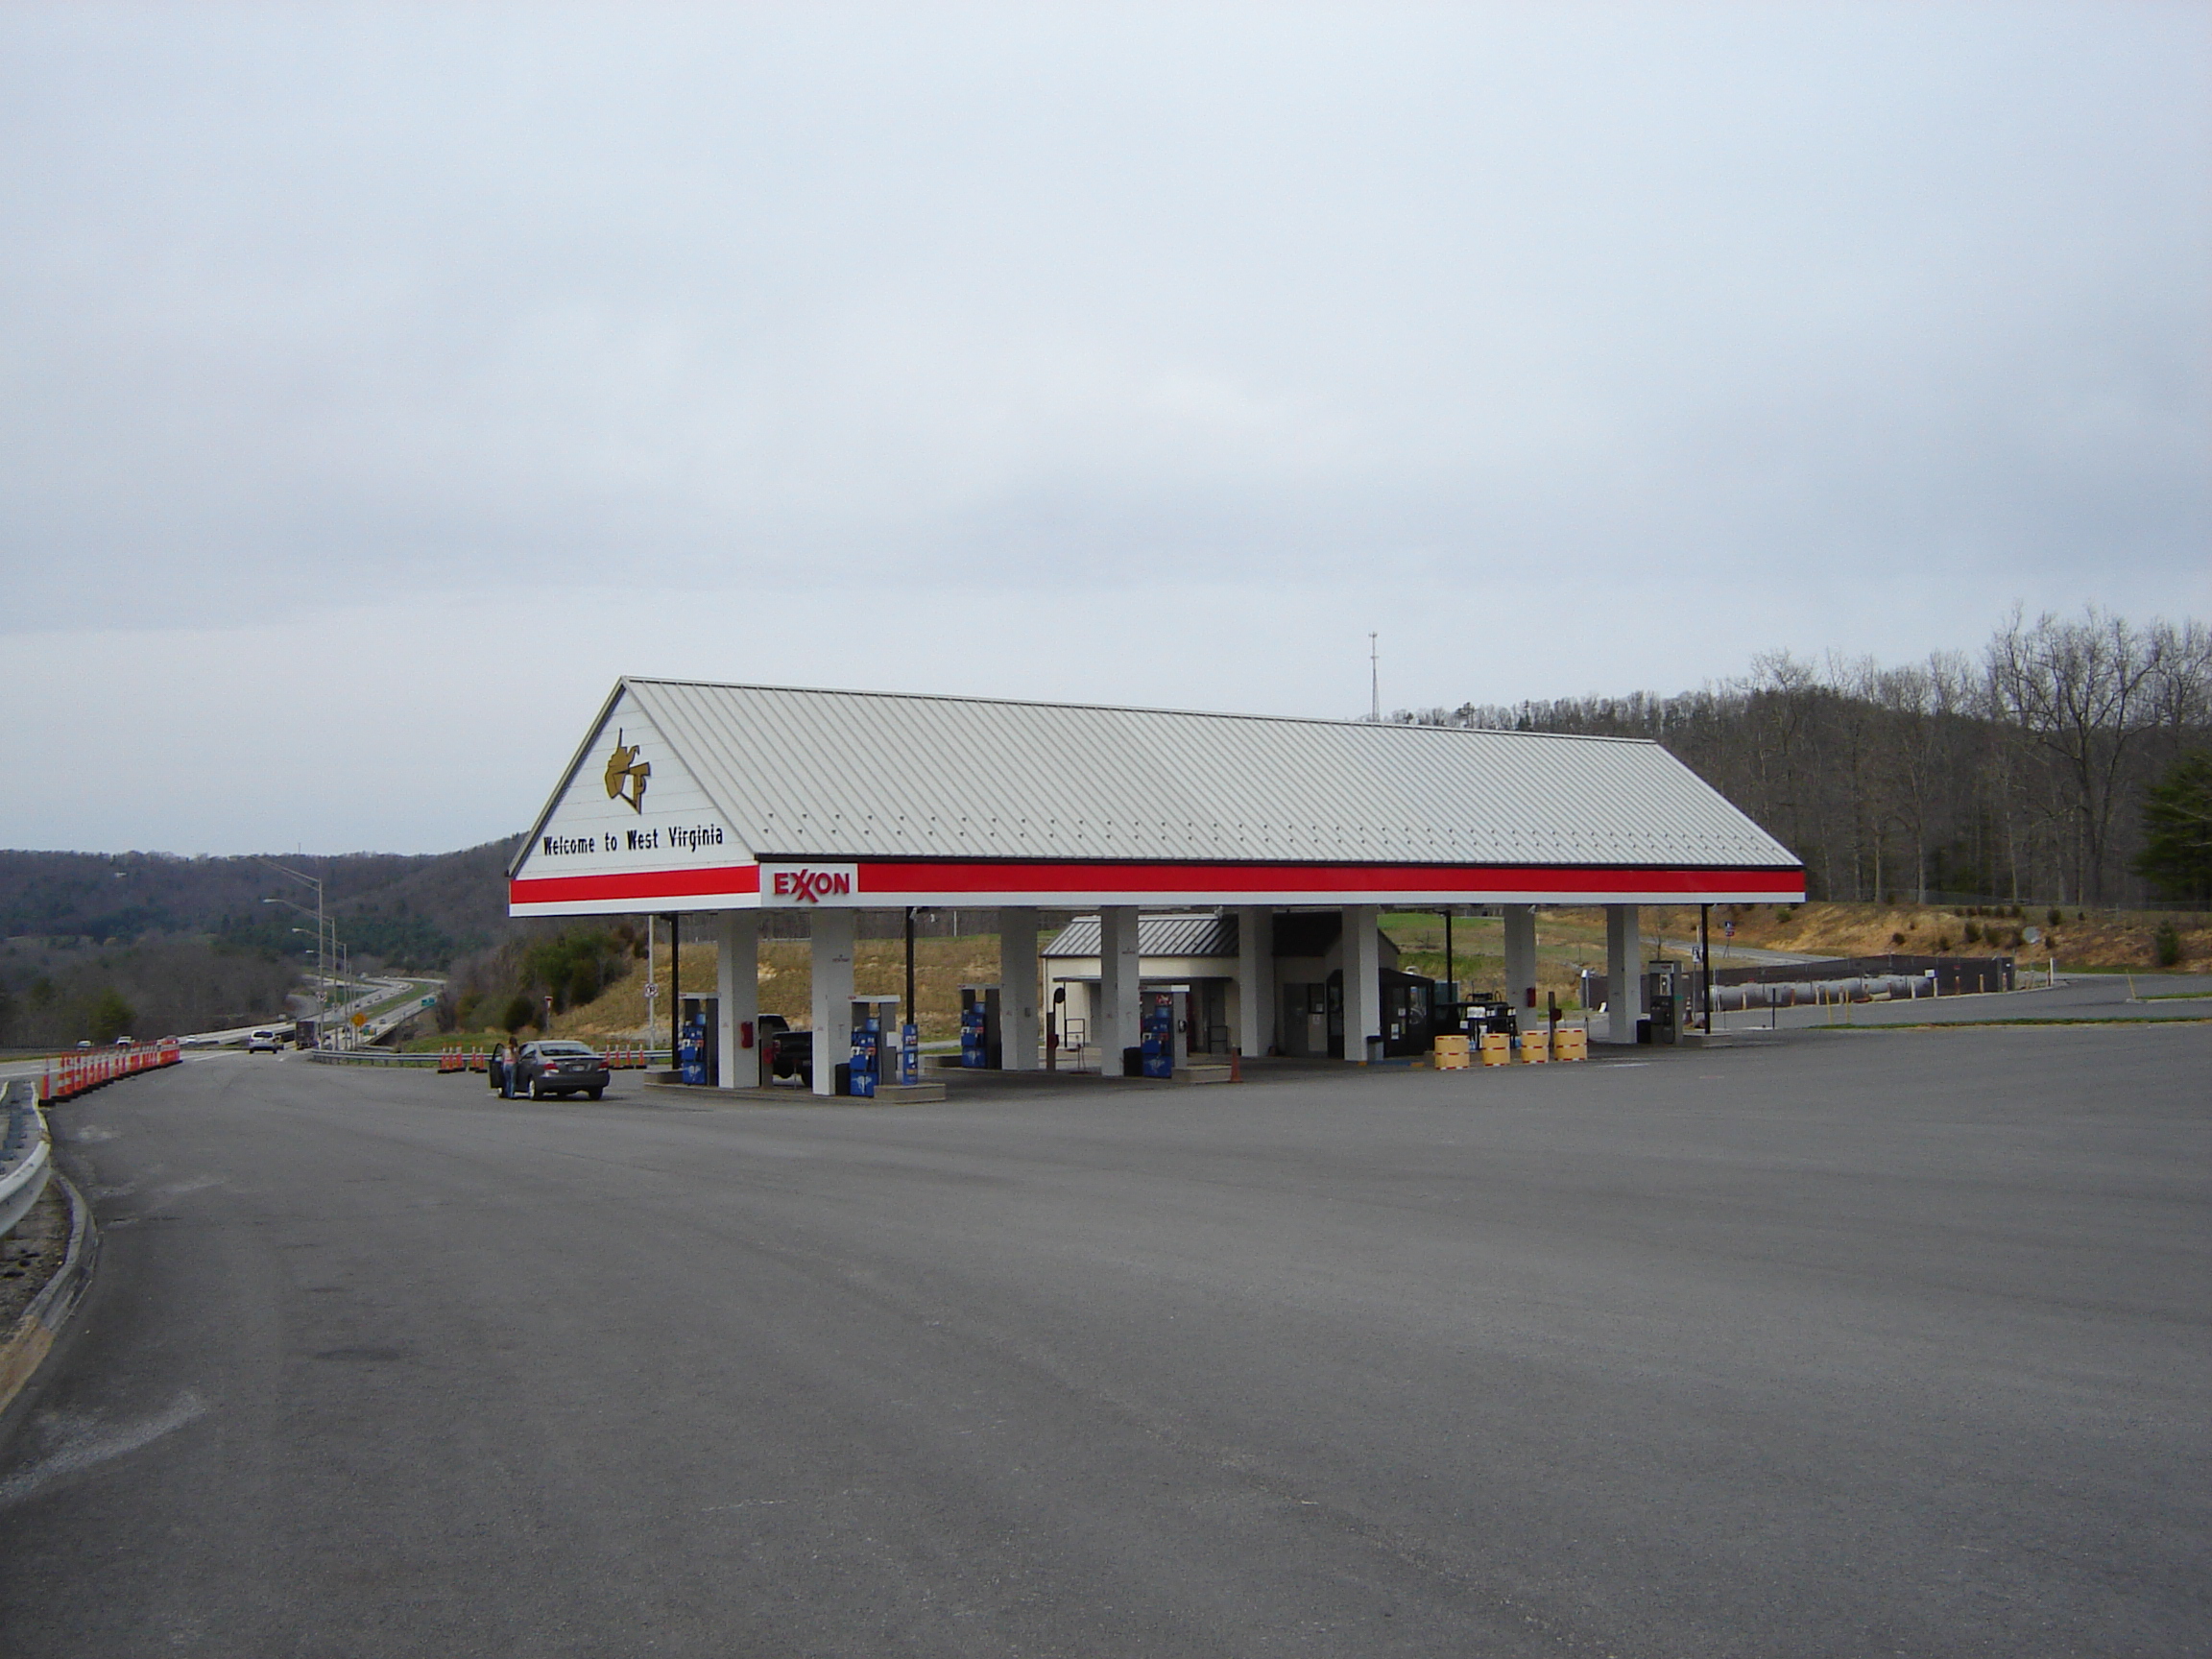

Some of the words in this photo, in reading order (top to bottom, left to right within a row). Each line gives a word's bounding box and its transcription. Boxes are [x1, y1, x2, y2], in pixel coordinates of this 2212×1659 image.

[543, 835, 595, 855] Welcome
[605, 831, 617, 852] to
[627, 828, 659, 850] West
[668, 824, 724, 853] Virginia
[774, 869, 850, 902] EXXON
